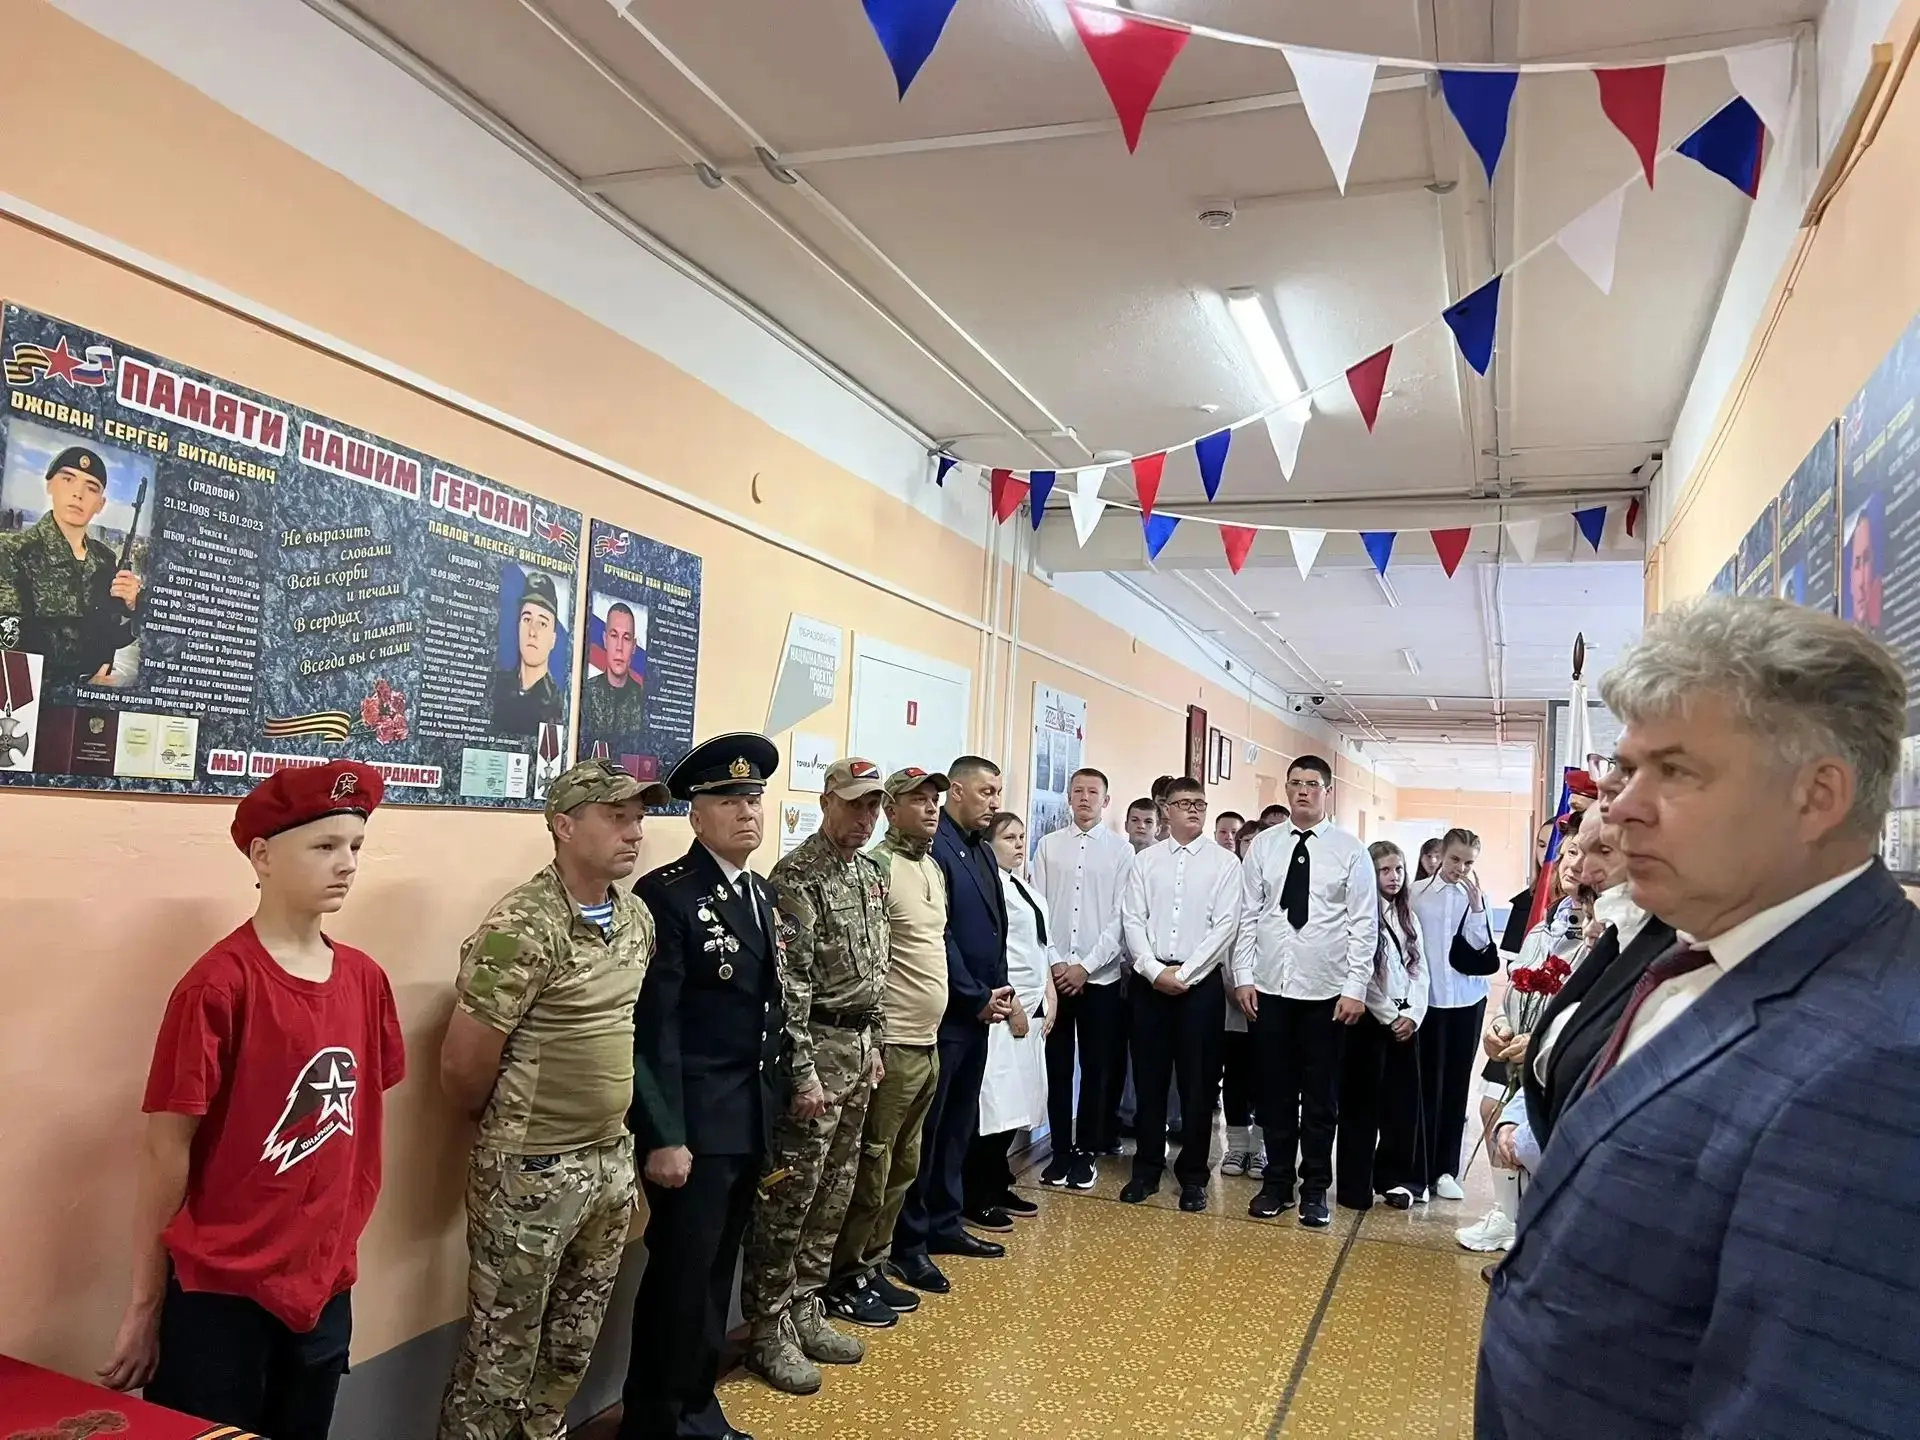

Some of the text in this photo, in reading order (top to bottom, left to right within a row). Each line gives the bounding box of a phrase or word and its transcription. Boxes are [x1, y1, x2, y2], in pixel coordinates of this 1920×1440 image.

[10, 390, 277, 484] ОЖОВАН СЕРГЕЙ ВИТАЛЬЕВИЧ
[119, 359, 529, 533] ПАМЯТИ НАШИМ ГЕРОЯМ
[188, 478, 240, 502] (рядовой)
[163, 496, 210, 518] 21.12.1998
[280, 526, 372, 548] Не выразить
[428, 520, 575, 575] ПАВЛОВ АЛЕКСЕЙ ВИКТОРОВИЧ
[340, 544, 392, 561] словами
[175, 575, 193, 587] 2017
[227, 574, 244, 586] 2015
[287, 562, 369, 590] Всей скорби
[346, 583, 400, 602] и печали
[293, 609, 364, 634] В сердцах
[352, 621, 413, 643] и памяти
[299, 651, 345, 676] Всегда
[349, 652, 366, 665] вы
[369, 648, 376, 660] с
[379, 641, 411, 658] нами
[210, 752, 244, 772] МЫ
